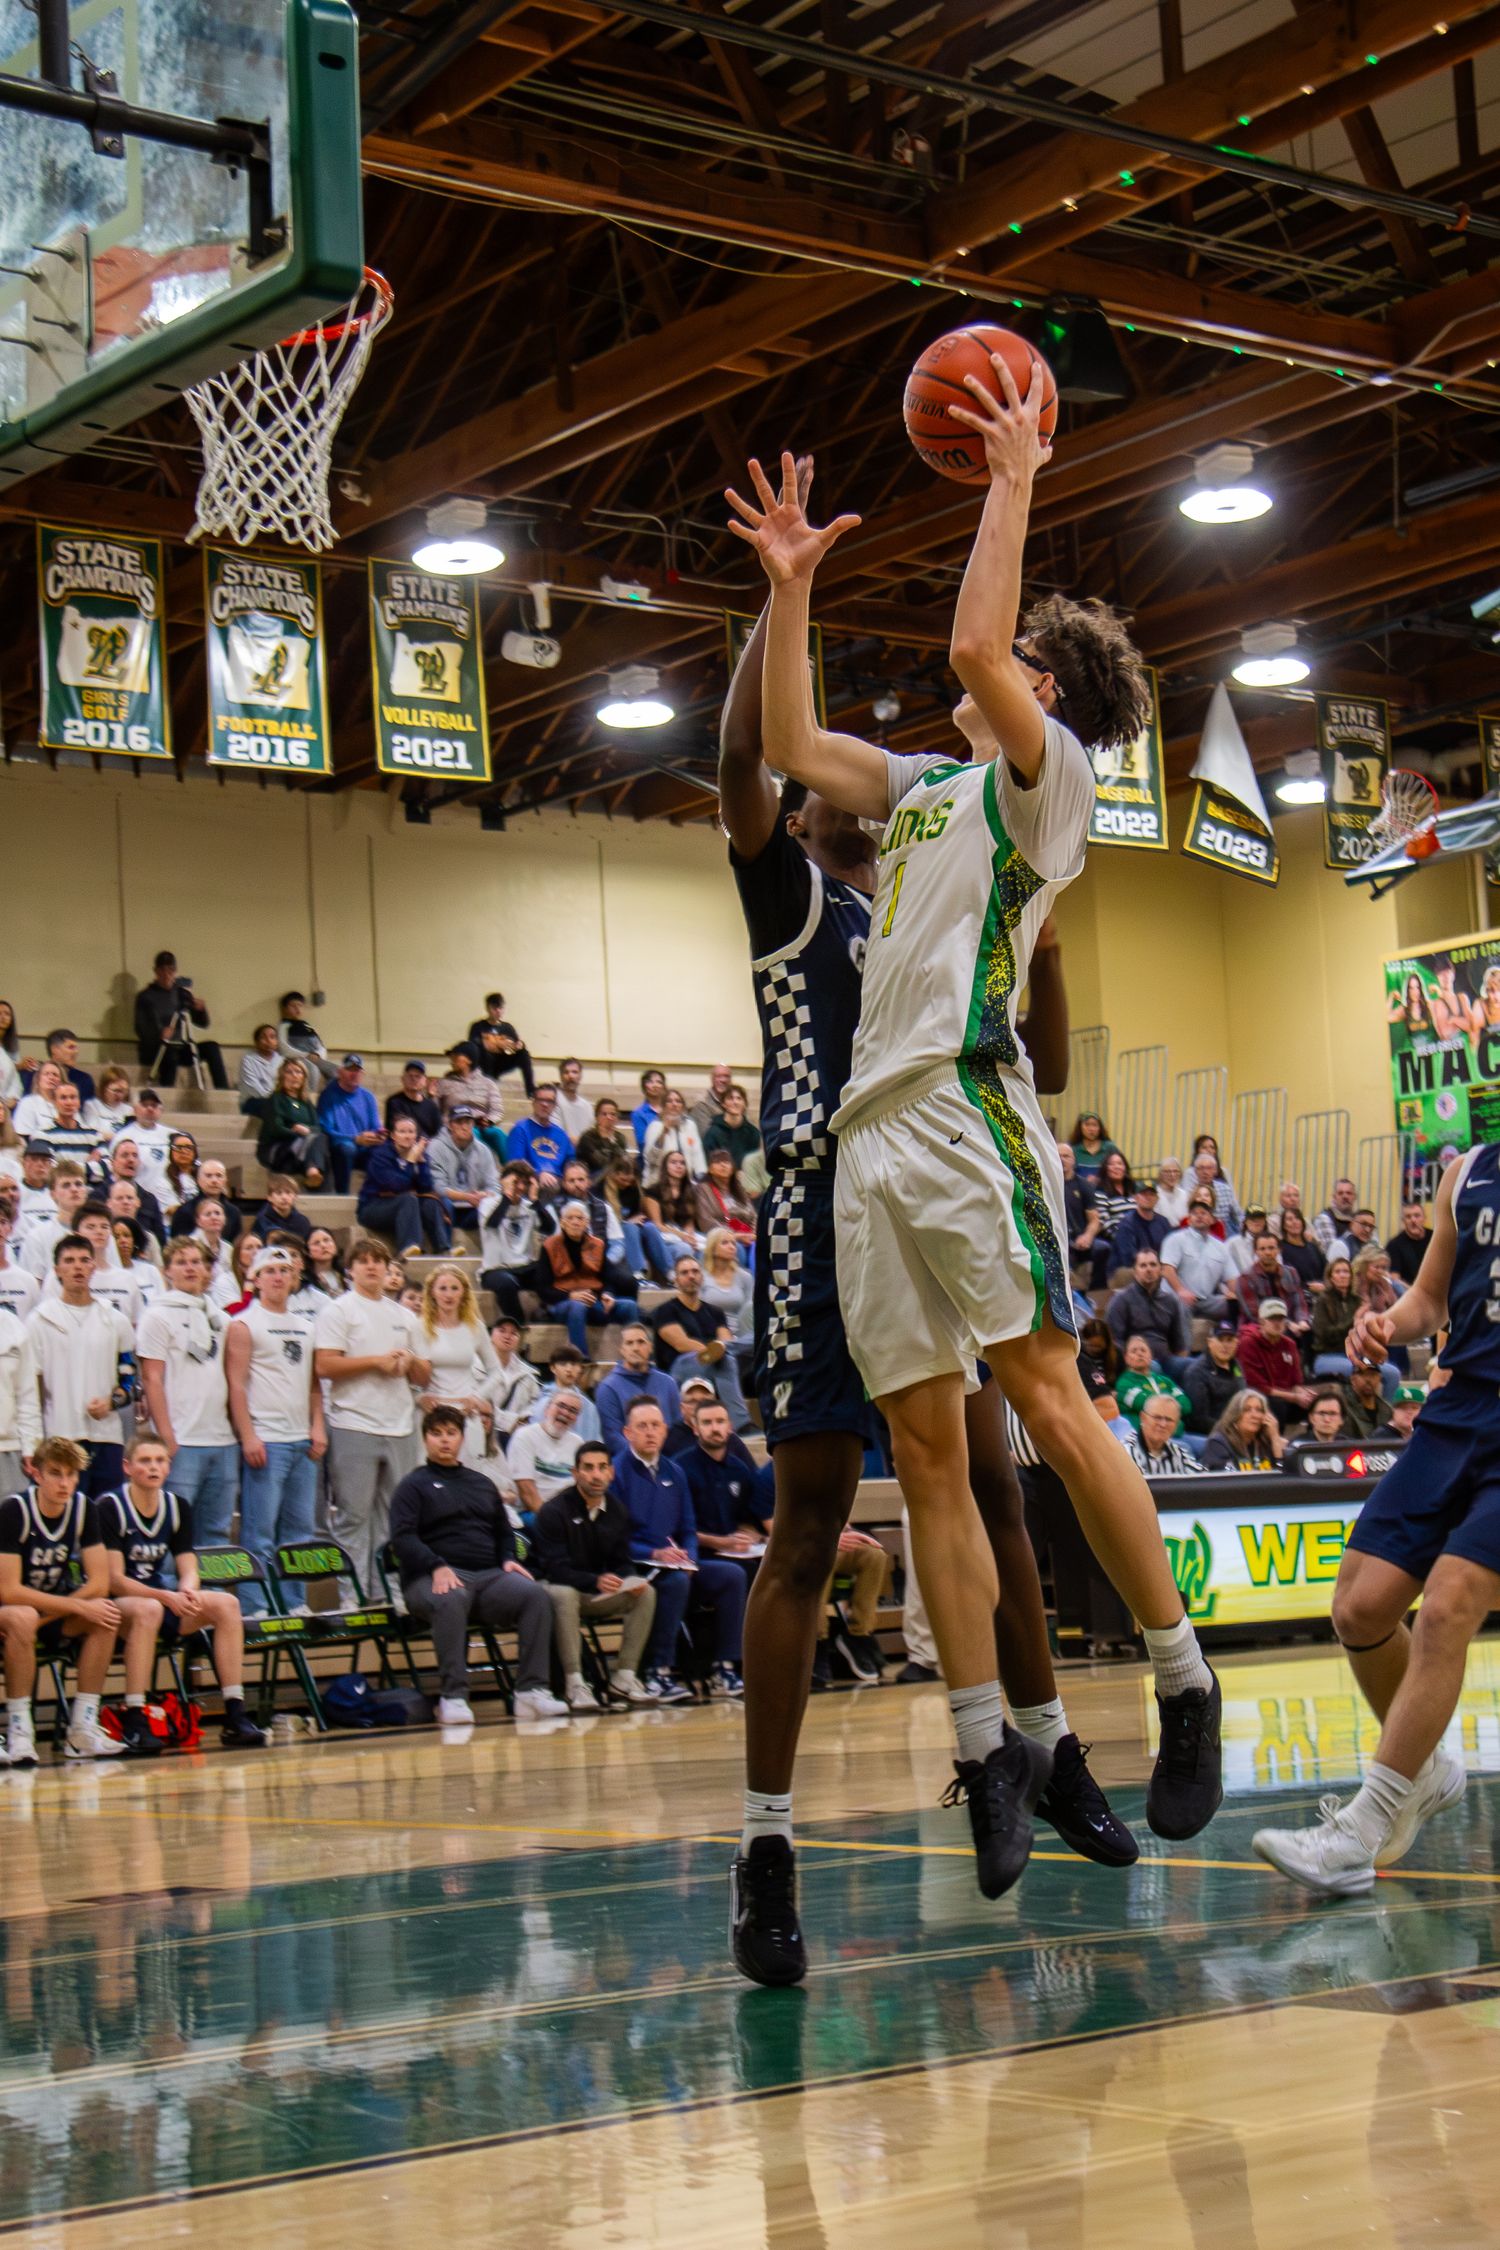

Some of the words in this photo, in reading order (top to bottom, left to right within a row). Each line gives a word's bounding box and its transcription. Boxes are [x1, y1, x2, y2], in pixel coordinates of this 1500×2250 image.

[56, 541, 141, 574] STATE
[46, 563, 155, 614] CHAMPIONS
[223, 564, 304, 594] STATE
[392, 575, 460, 605] STATE
[213, 586, 315, 632] CHAMPIONS
[384, 600, 469, 637] CHAMPIONS
[82, 689, 129, 706] GIRLS
[83, 704, 129, 722] GOLF
[216, 715, 317, 740] FOOTBALL
[381, 705, 477, 732] VOLLEYBALL
[1329, 704, 1379, 728] STATE
[63, 719, 150, 751] 2016
[227, 734, 310, 766] 2016
[391, 734, 473, 770] 2021
[1095, 784, 1155, 805] BASEBALL
[1094, 808, 1158, 838] 2022
[1198, 822, 1268, 868] 2023
[882, 861, 907, 937] 1
[279, 1547, 344, 1574] LIONS
[1237, 1519, 1357, 1587] WE
